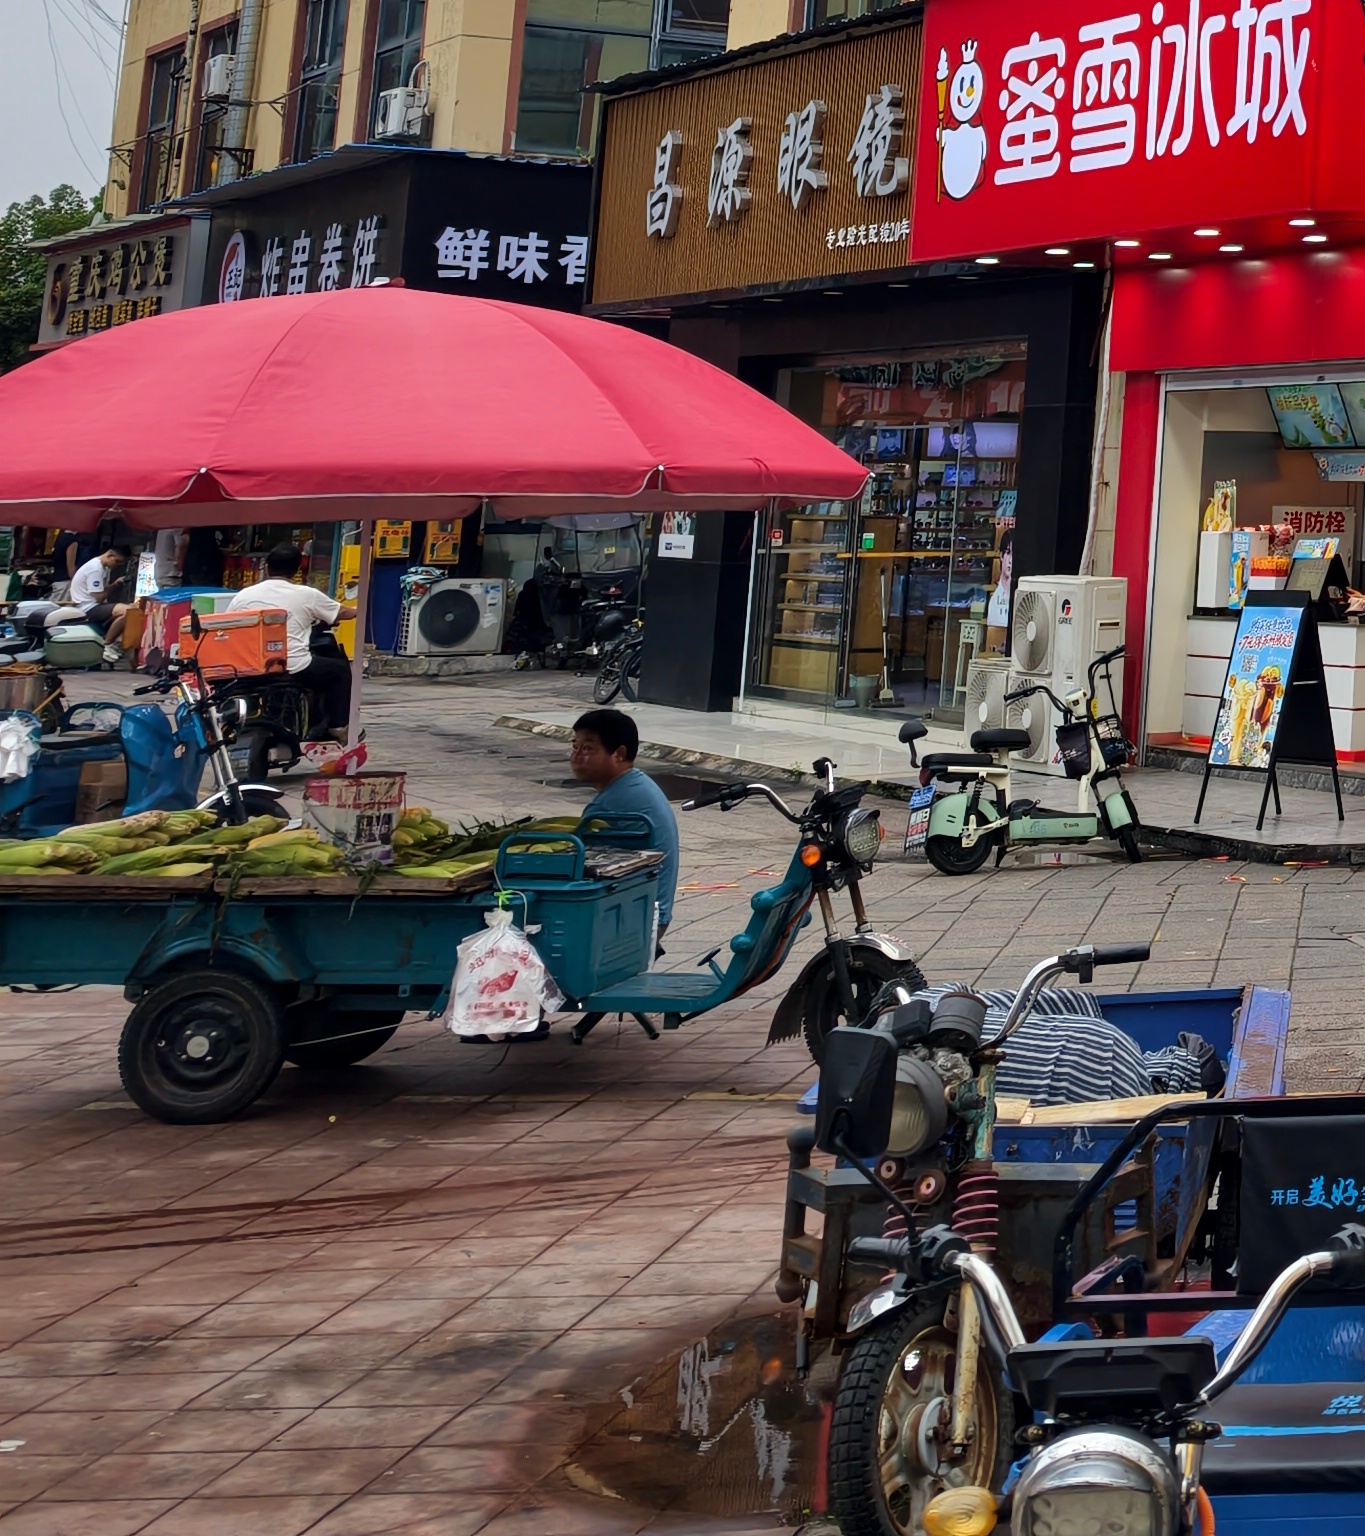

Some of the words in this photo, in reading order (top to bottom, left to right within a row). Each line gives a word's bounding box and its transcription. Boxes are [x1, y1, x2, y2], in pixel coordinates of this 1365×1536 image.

[646, 84, 907, 238] 昌源眼镜
[66, 236, 174, 304] 重庆鸡公煲
[1283, 511, 1346, 534] 消防栓
